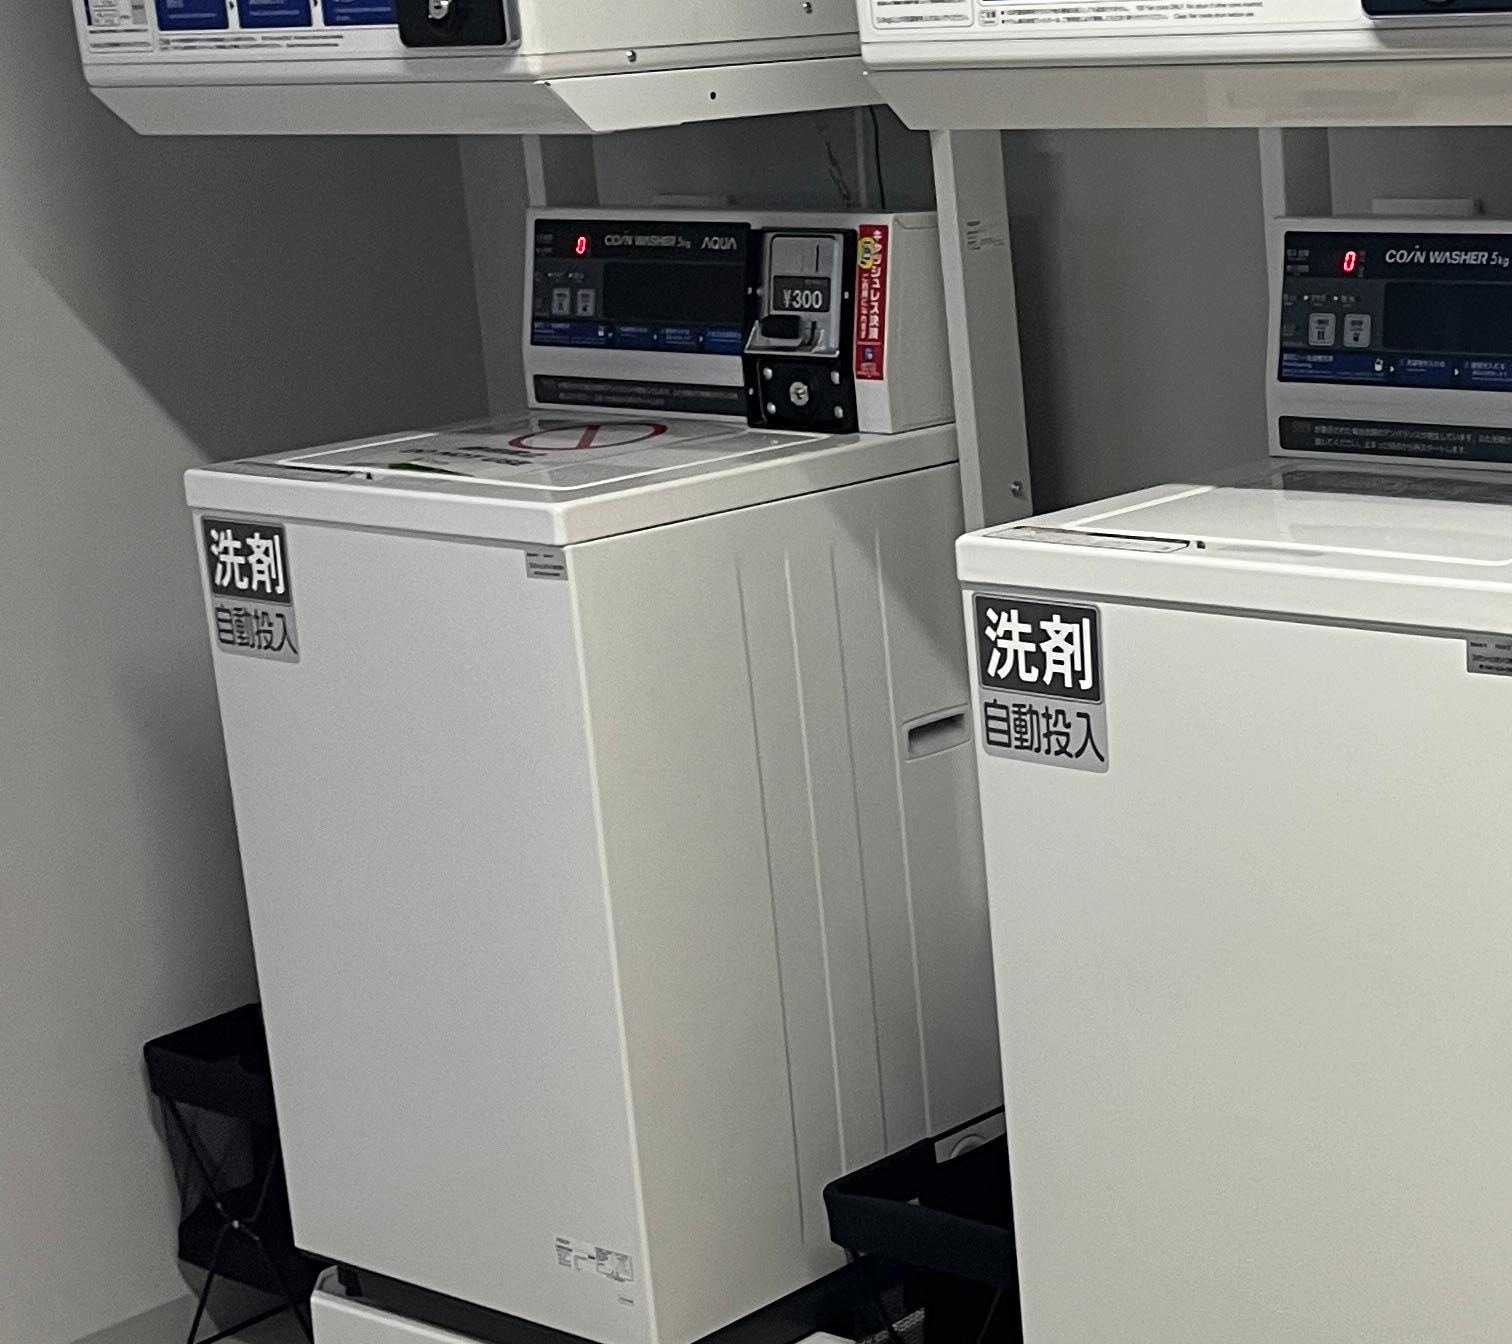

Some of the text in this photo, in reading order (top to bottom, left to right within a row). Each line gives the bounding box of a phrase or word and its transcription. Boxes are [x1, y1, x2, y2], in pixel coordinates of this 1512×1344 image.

[576, 236, 587, 254] 0
[701, 236, 737, 250] AQUA
[1429, 250, 1487, 265] WASHER
[1343, 250, 1357, 272] 0
[208, 528, 286, 596] 洗剤
[215, 606, 299, 655] 自動投入
[984, 607, 1093, 690] 洗剤
[984, 698, 1105, 762] 自動投入
